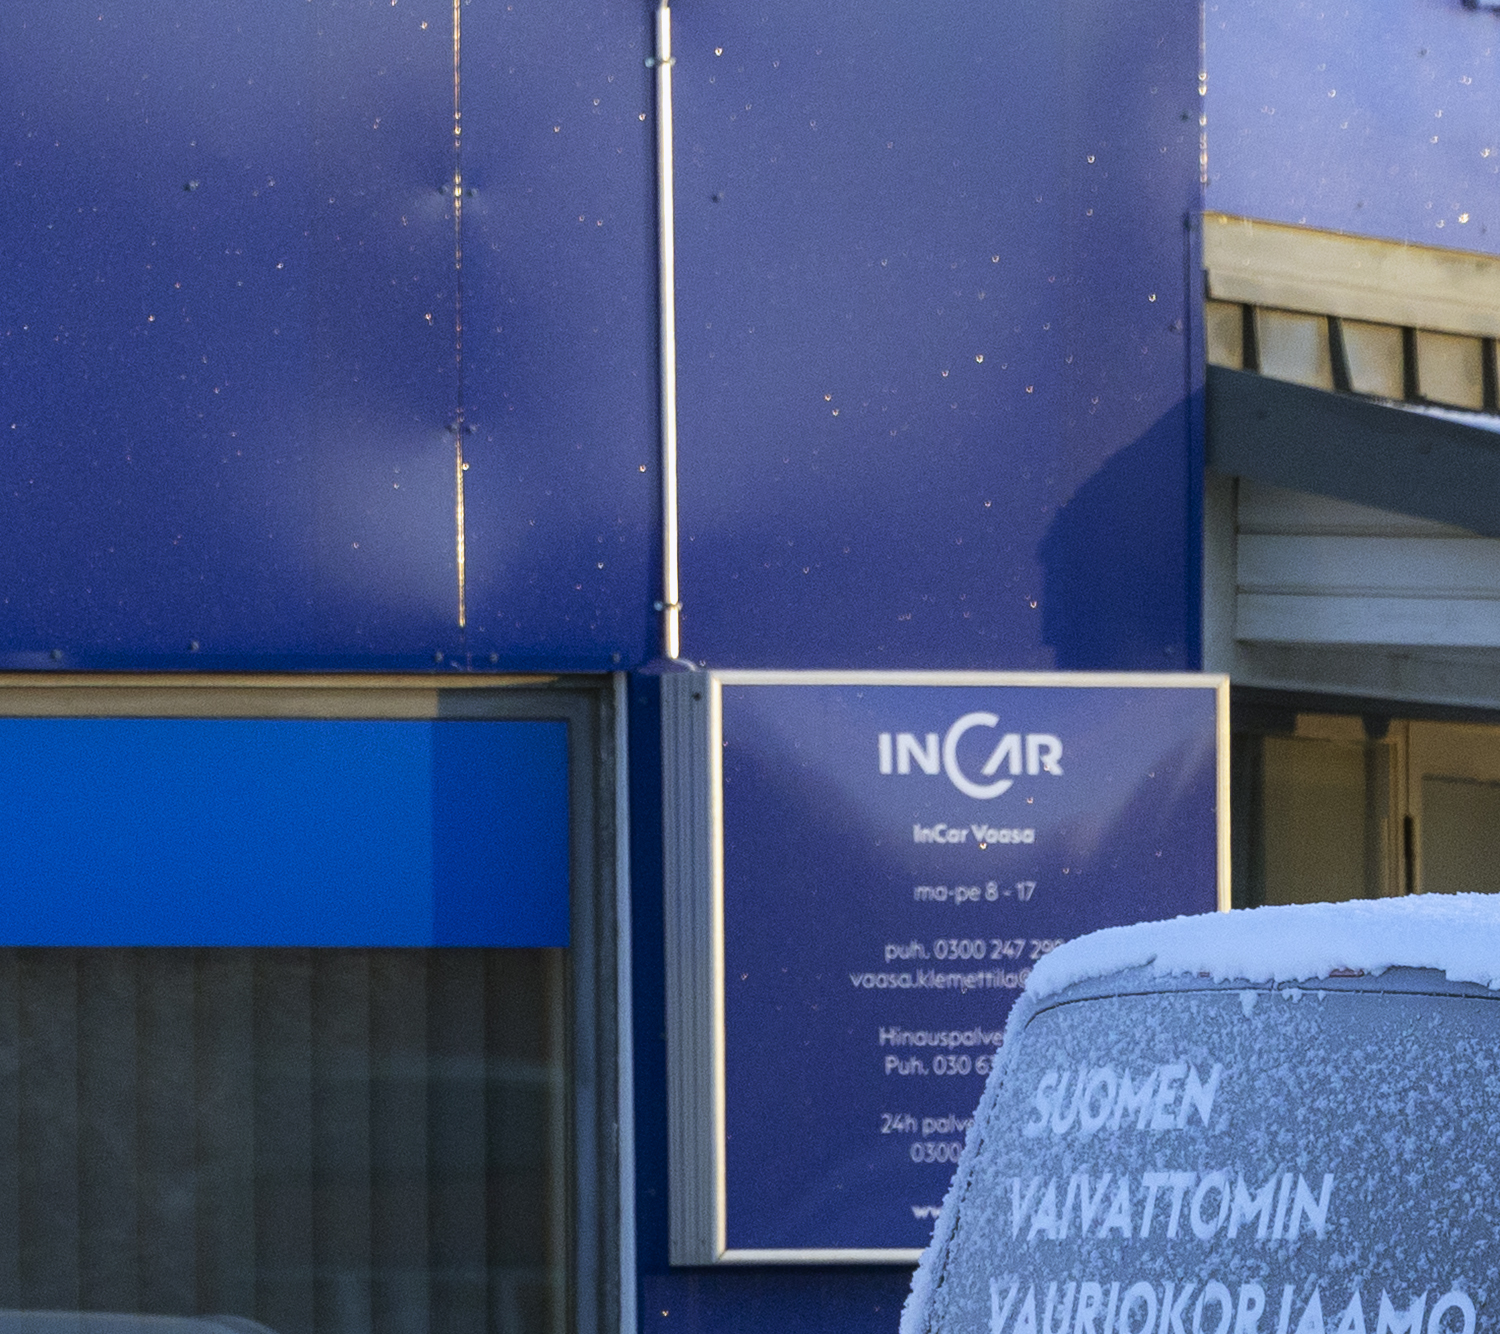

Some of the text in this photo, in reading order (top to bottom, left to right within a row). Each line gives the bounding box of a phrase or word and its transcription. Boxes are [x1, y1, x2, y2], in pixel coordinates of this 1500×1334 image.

[878, 711, 1065, 800] INCAR
[912, 822, 1036, 845] InCar Vaasa
[913, 884, 982, 906] ma-pe
[984, 880, 999, 902] 8
[1015, 880, 1038, 902] 17
[884, 938, 930, 964] puh.
[932, 938, 987, 960] 0300
[990, 938, 1027, 960] 247
[885, 1054, 930, 1075] Puh.
[932, 1054, 972, 1075] 030
[1024, 1061, 1223, 1135] SUOMEN
[881, 1113, 919, 1134] 24h
[910, 1141, 962, 1164] 0300
[1010, 1170, 1335, 1242] VAIVATTOMIN
